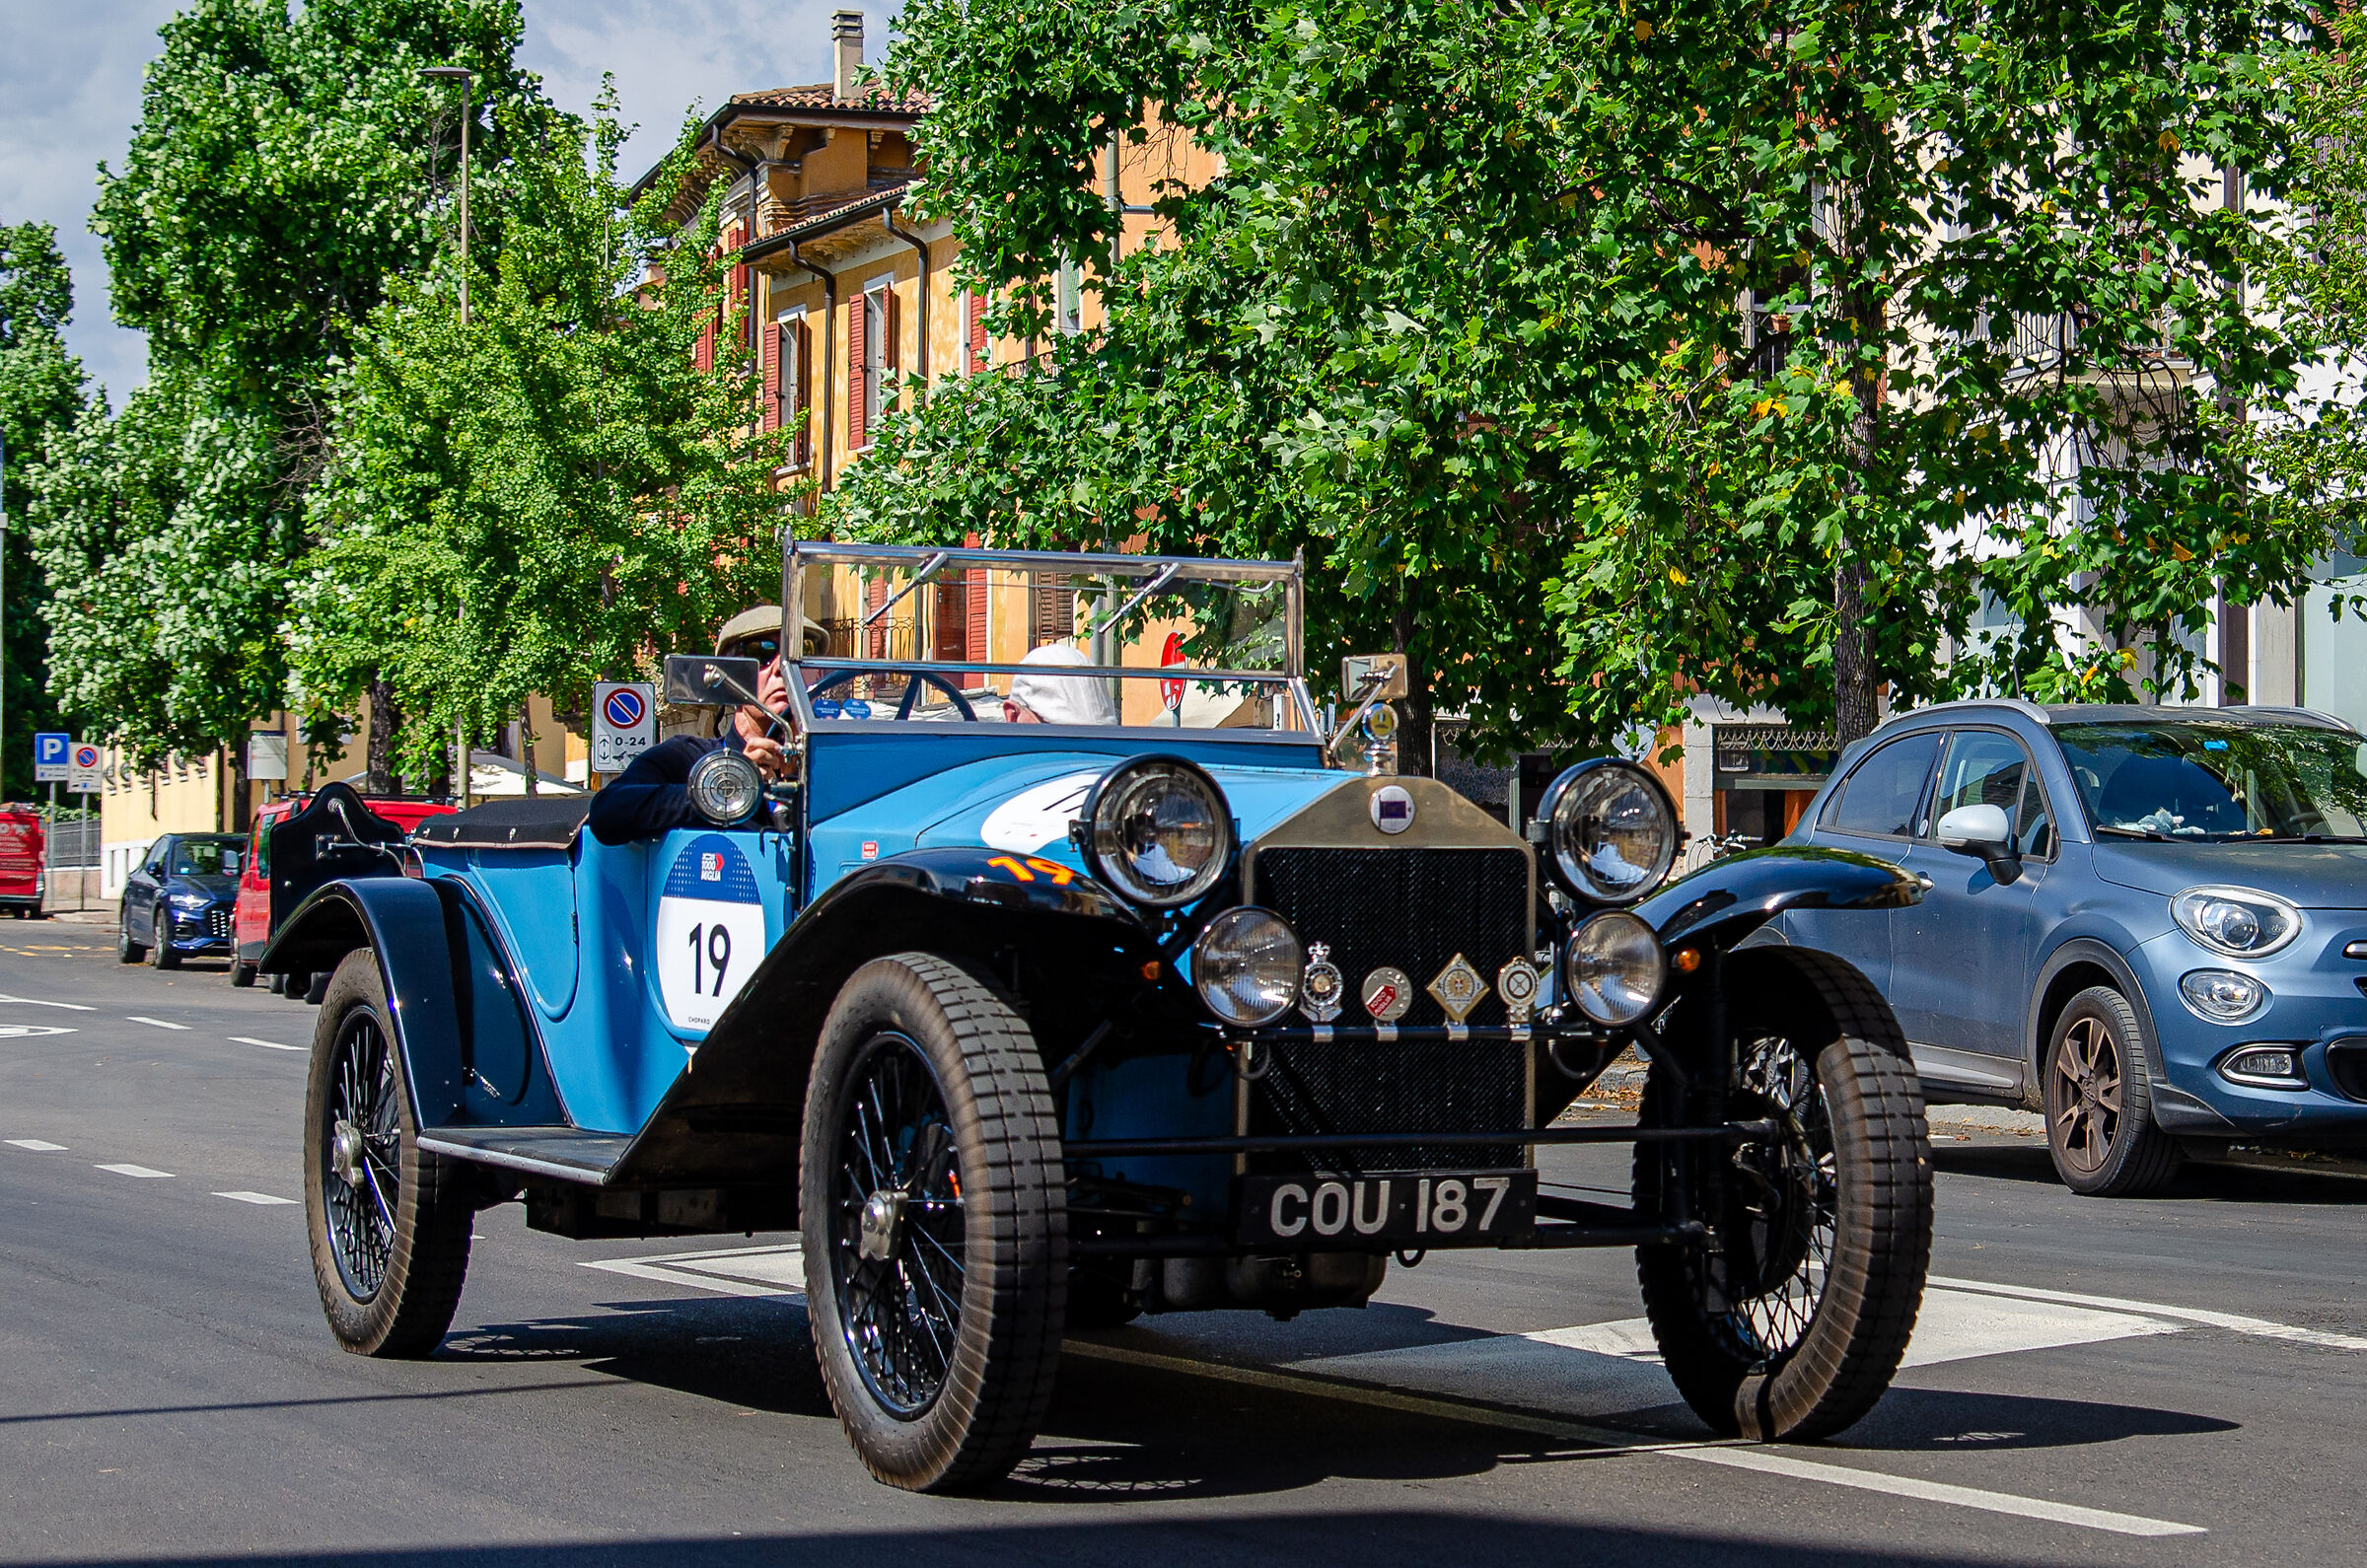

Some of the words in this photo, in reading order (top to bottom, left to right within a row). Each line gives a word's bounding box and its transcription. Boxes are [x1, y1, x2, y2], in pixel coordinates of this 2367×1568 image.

[42, 738, 63, 760] P
[615, 737, 646, 746] 0-24
[987, 855, 1075, 886] 19
[688, 922, 731, 998] 19
[1270, 1179, 1391, 1237] COU
[1416, 1177, 1510, 1233] 187
